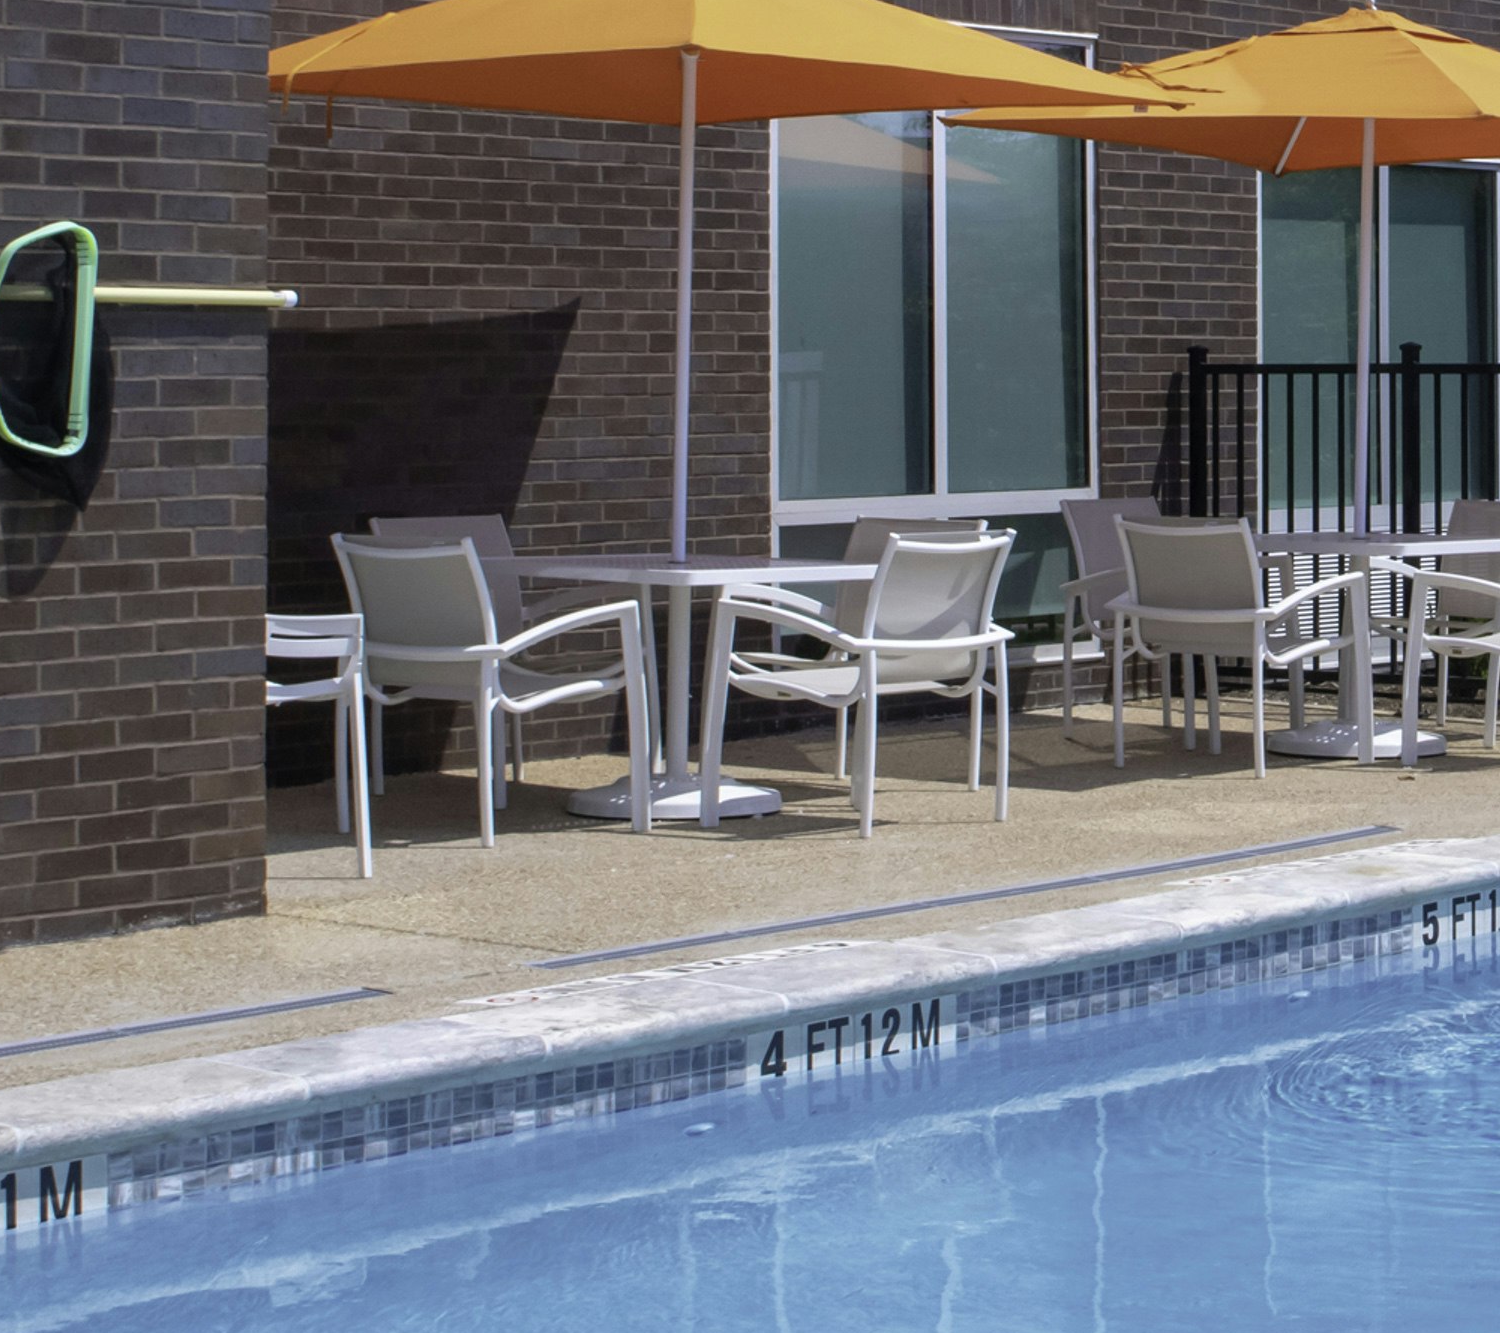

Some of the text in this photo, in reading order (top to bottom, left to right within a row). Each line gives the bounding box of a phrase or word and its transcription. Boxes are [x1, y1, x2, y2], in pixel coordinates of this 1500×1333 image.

[1422, 902, 1440, 945] 5
[1452, 893, 1481, 940] FT
[761, 1030, 787, 1077] 4
[807, 1017, 849, 1070] FT
